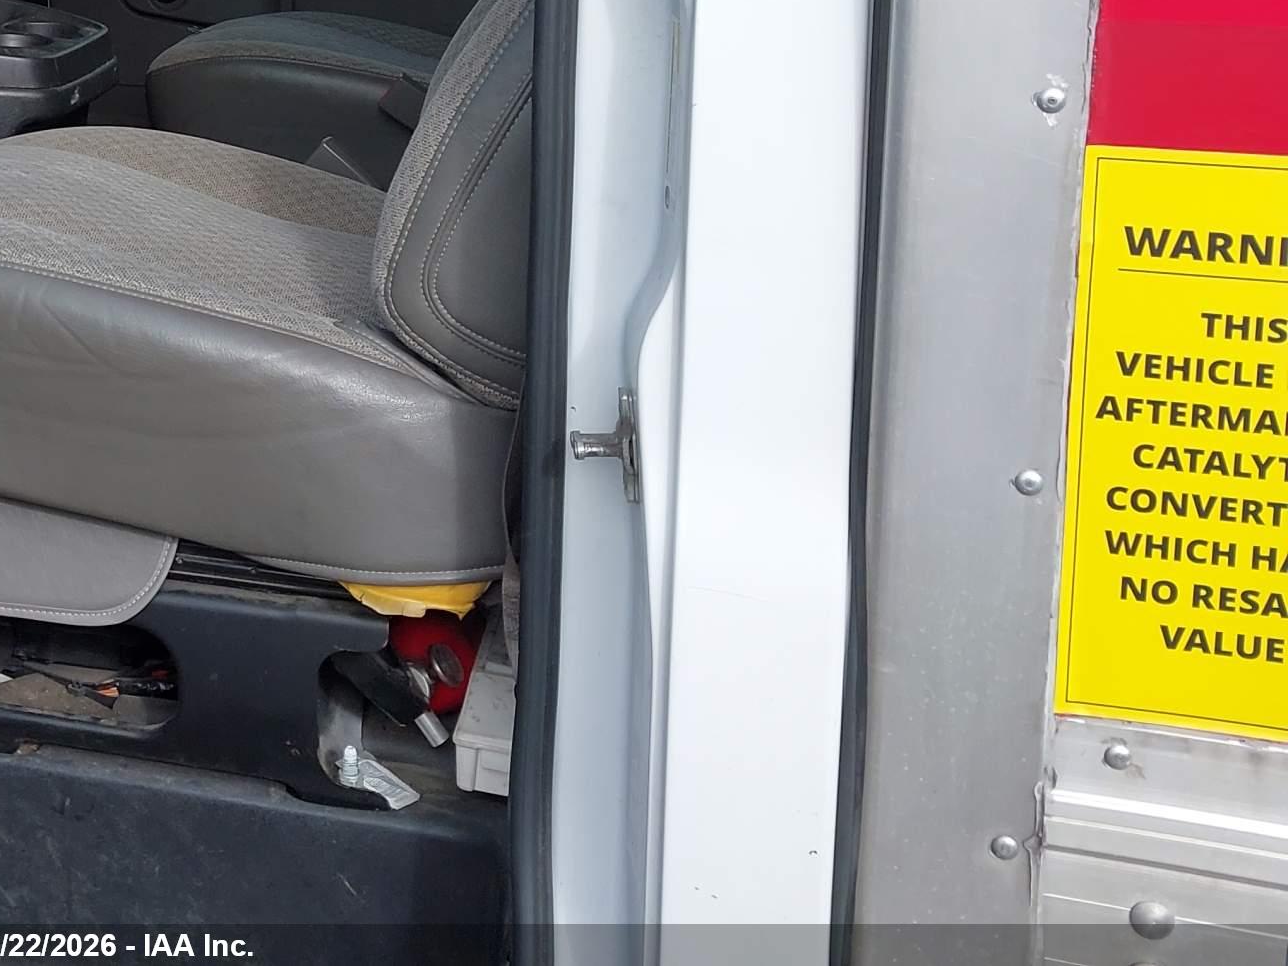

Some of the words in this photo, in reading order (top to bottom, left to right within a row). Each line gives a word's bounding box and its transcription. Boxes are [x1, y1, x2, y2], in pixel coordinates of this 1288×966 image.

[1124, 225, 1288, 267] WARNI
[1201, 312, 1288, 344] THIS
[1115, 350, 1275, 389] VEHICLE
[1095, 395, 1288, 437] AFTERMA
[1106, 486, 1288, 527] CONVERT
[1104, 530, 1237, 567] WHICH
[1120, 576, 1178, 605] NO
[1192, 584, 1288, 619] RESA
[1160, 625, 1285, 664] VALUE
